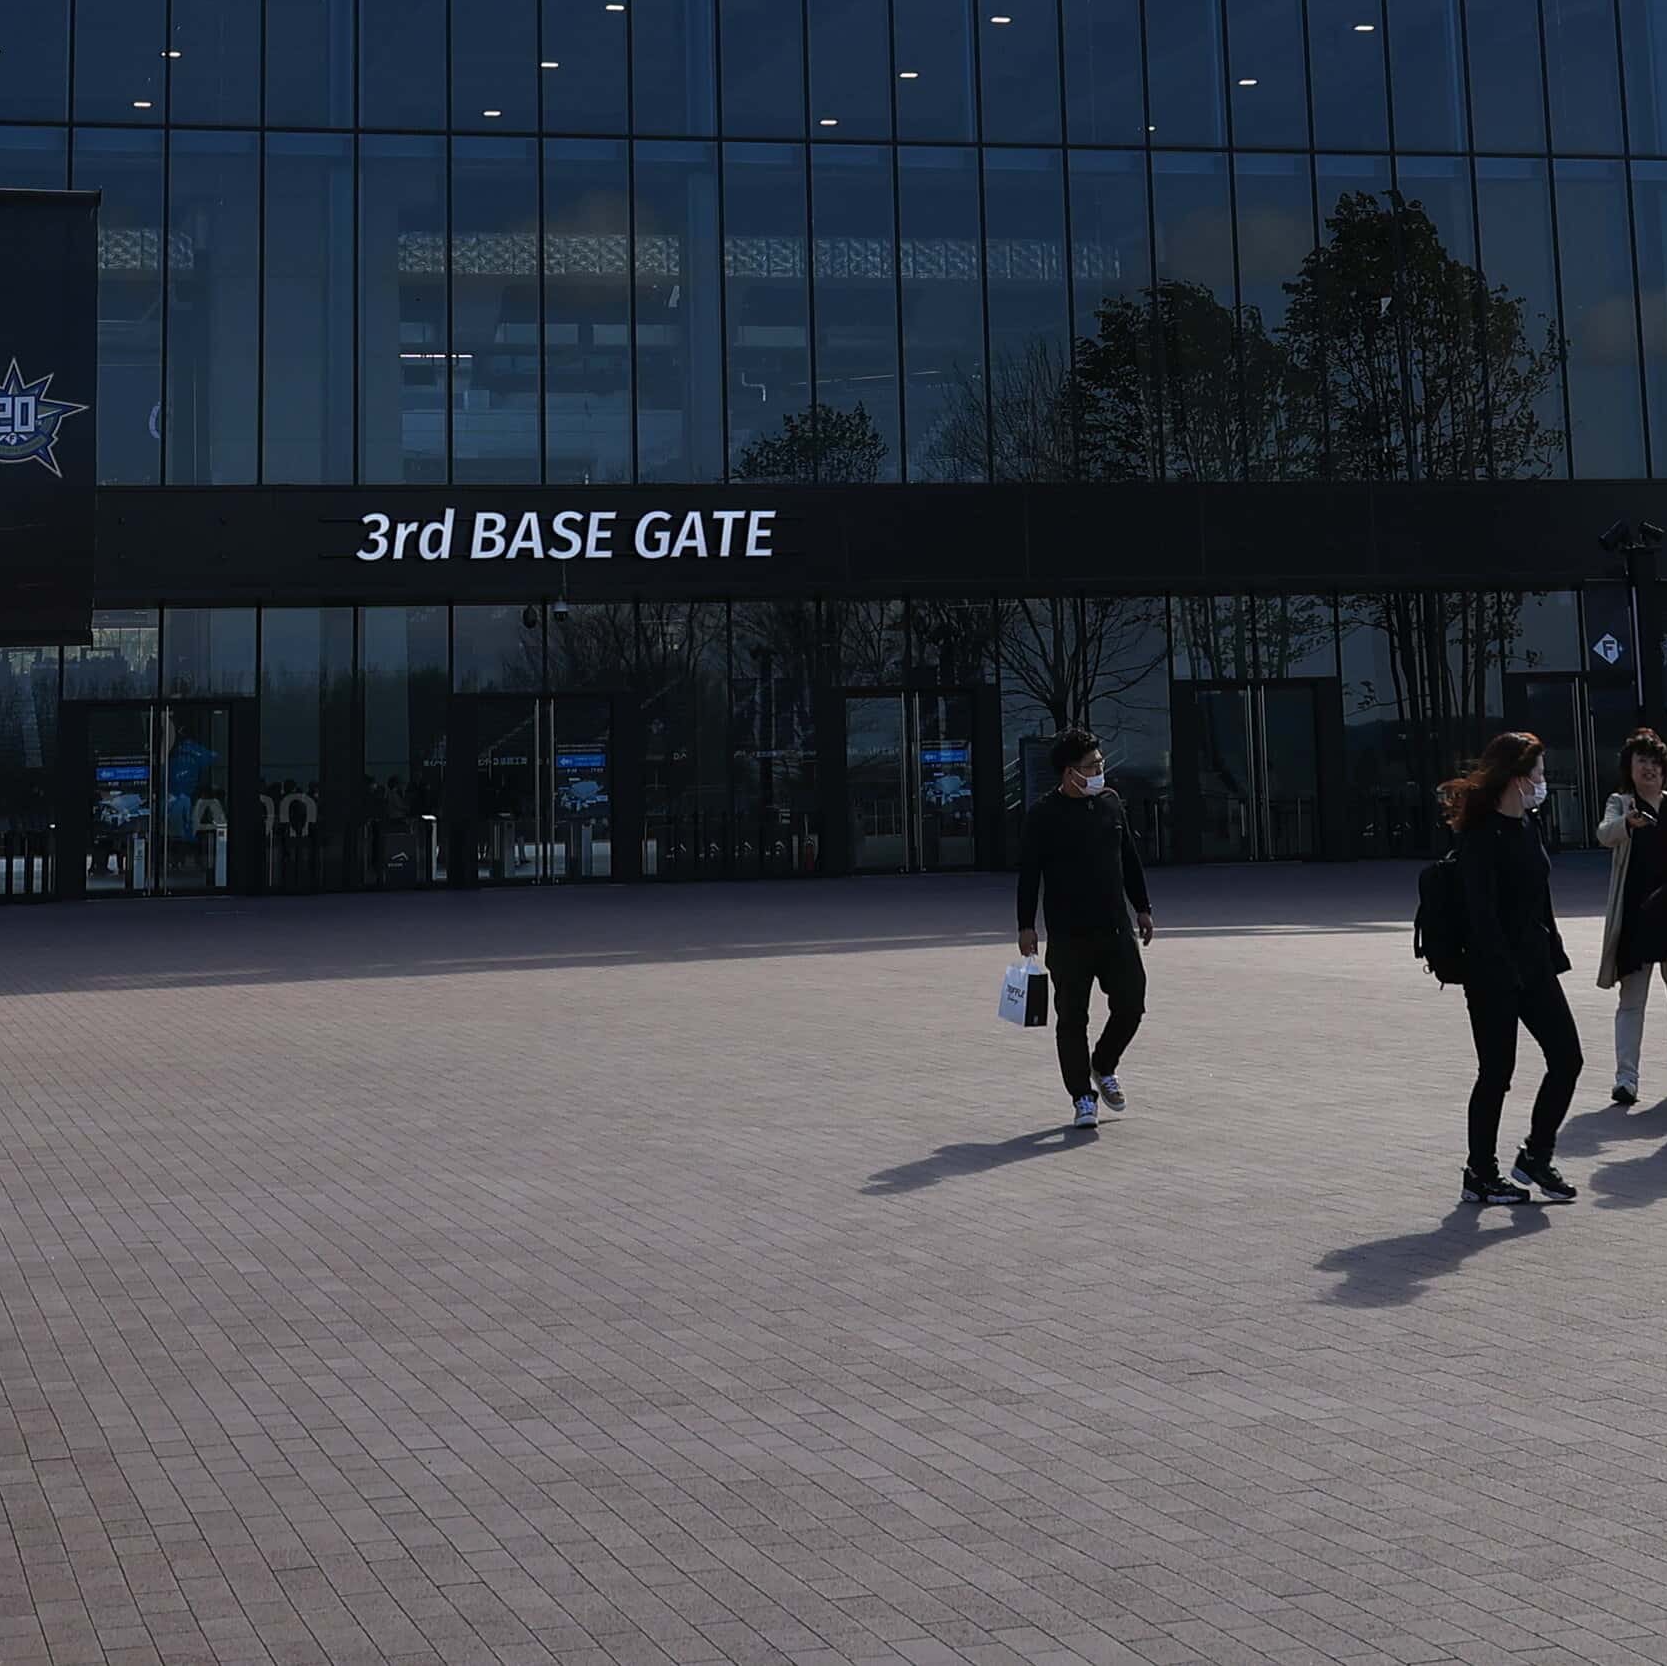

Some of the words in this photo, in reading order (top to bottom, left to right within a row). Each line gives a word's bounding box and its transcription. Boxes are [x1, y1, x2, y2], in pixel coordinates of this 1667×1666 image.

[355, 507, 457, 562] 3rd
[470, 510, 618, 560] BASE
[634, 509, 778, 560] GATE
